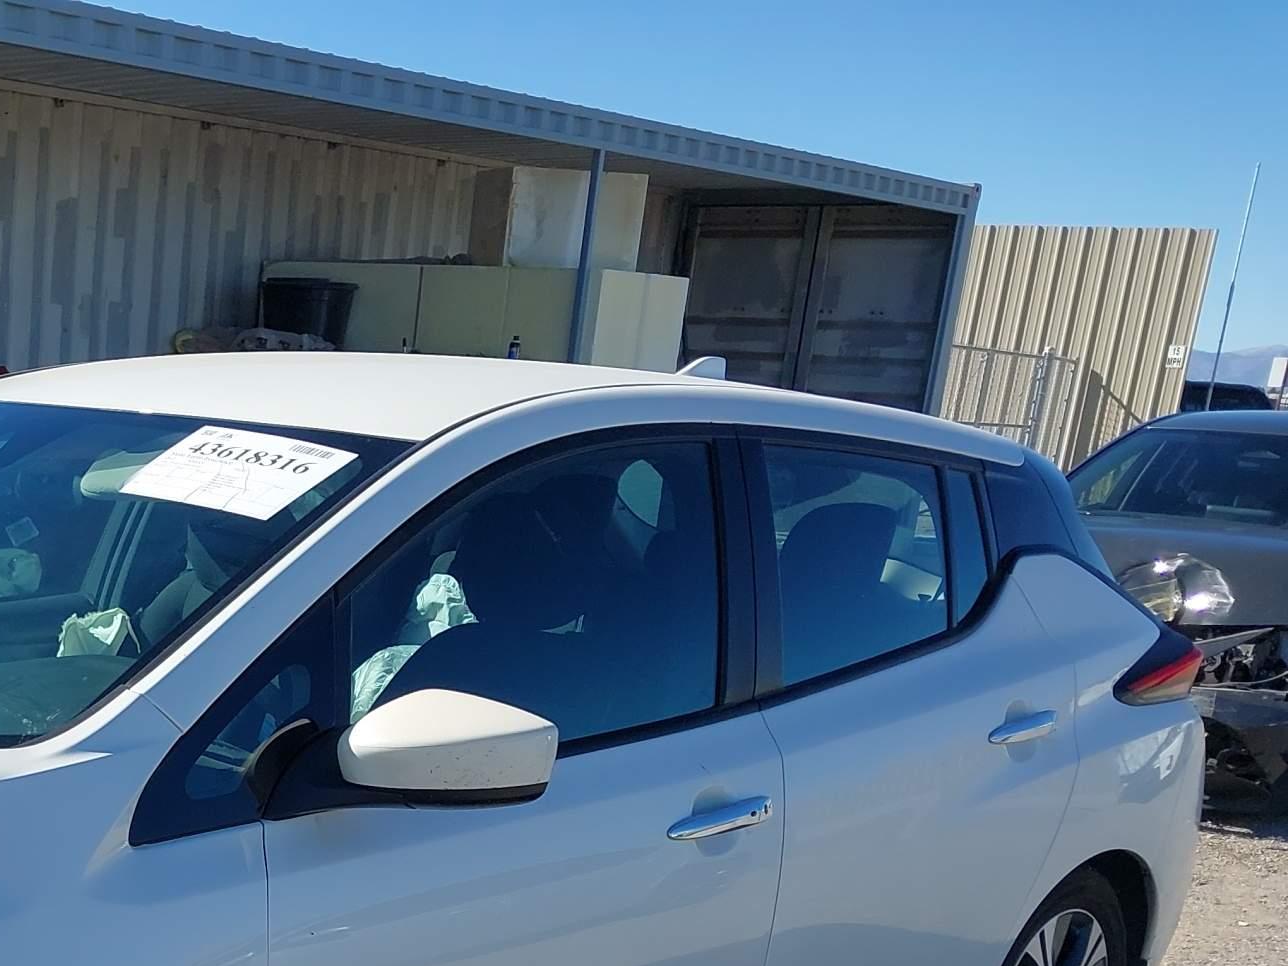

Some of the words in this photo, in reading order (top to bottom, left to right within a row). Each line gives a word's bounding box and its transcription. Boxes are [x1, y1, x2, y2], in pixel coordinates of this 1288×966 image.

[1173, 347, 1181, 356] 15
[1166, 357, 1182, 366] MPH
[188, 441, 319, 475] 43618316
